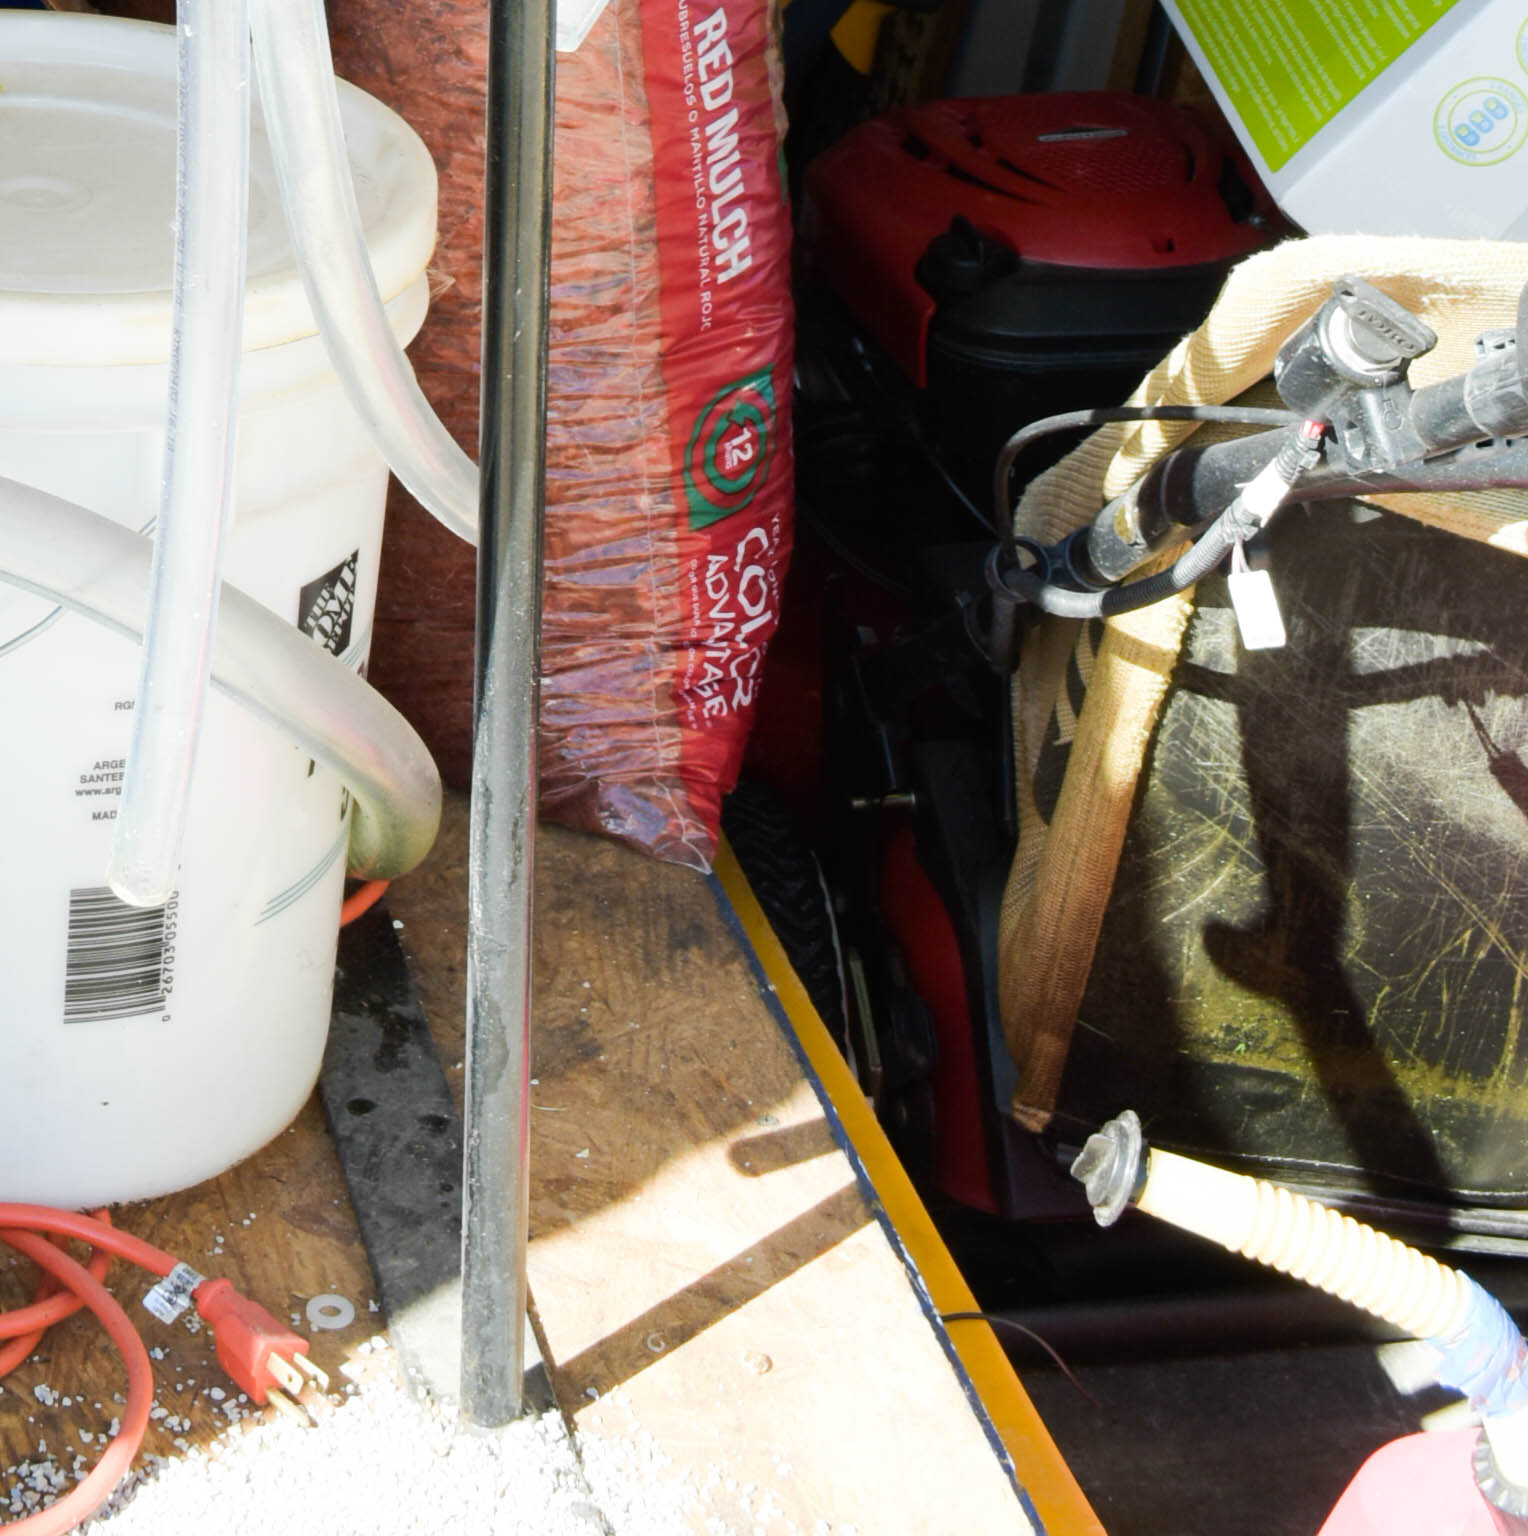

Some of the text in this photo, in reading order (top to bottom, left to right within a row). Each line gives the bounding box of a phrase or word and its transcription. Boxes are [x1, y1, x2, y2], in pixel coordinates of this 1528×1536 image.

[687, 109, 698, 122] O
[693, 7, 752, 285] RED MULCH
[689, 127, 706, 208] MANTILLO
[696, 213, 709, 286] NATURAL
[724, 427, 754, 466] 12
[93, 759, 127, 771] ARGE
[75, 785, 122, 797] www.arg
[92, 810, 119, 821] MAD
[161, 945, 176, 995] 26703
